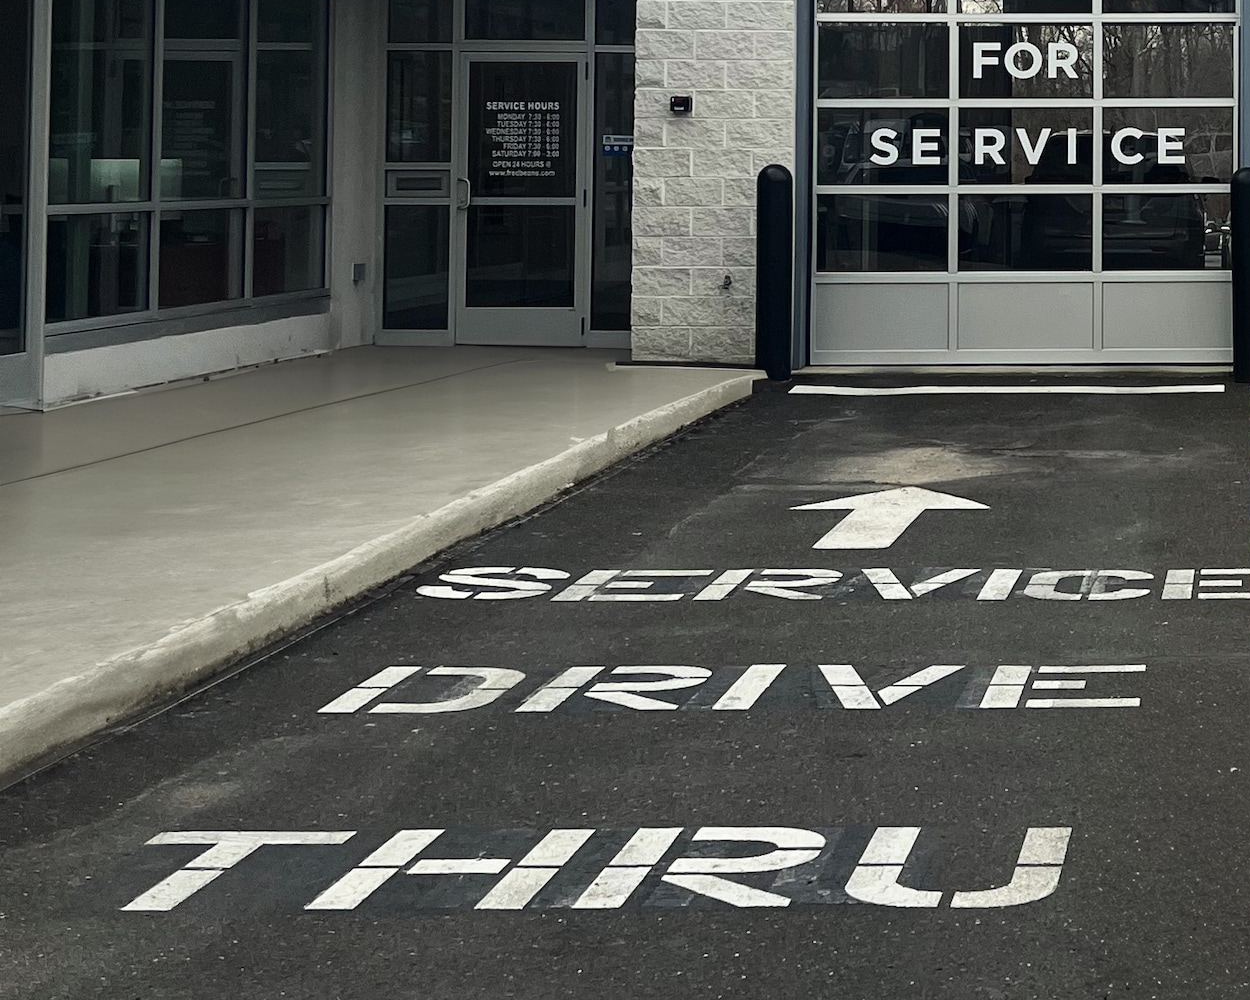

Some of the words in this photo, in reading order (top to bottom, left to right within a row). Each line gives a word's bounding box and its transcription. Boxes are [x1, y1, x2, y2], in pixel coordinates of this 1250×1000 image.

[972, 41, 1080, 80] FOR
[485, 101, 525, 110] SERVICE
[527, 101, 560, 110] HOURS
[869, 127, 1187, 166] SERVICE
[316, 663, 1147, 714] DRIVE
[119, 826, 1073, 912] THRU
